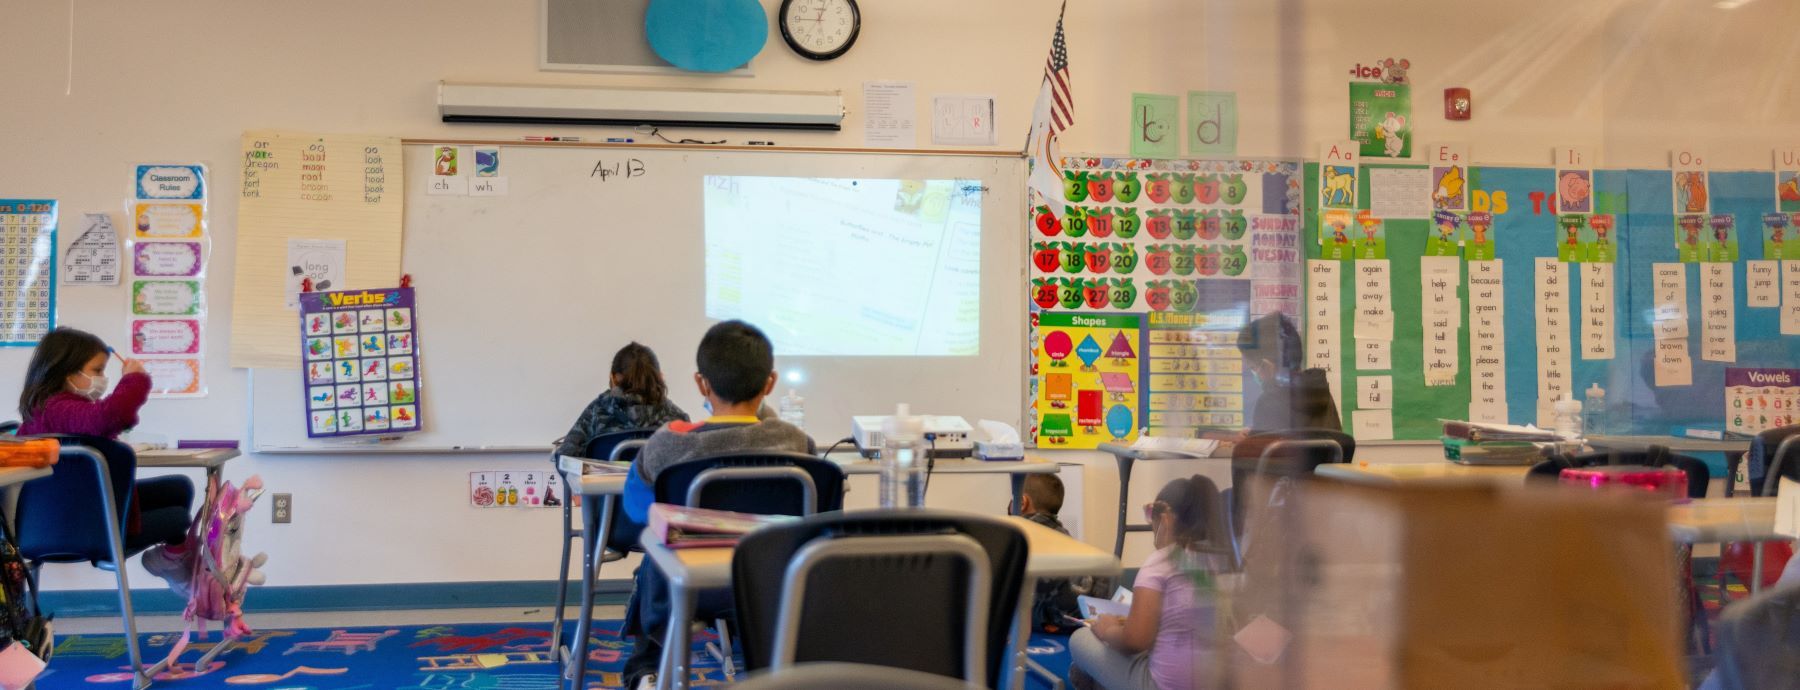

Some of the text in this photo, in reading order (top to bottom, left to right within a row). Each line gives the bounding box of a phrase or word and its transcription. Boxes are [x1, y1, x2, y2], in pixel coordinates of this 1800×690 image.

[1350, 63, 1382, 78] -ice
[974, 117, 980, 128] R
[1197, 104, 1220, 144] d
[254, 140, 270, 149] or
[310, 144, 324, 152] oo
[364, 146, 378, 154] oo
[1328, 145, 1352, 160] A a
[1440, 146, 1459, 161] E e
[244, 159, 279, 170] Oregon
[1679, 152, 1692, 166] O
[1783, 152, 1793, 166] U
[591, 158, 646, 182] April 13
[434, 182, 449, 190] ch
[476, 182, 494, 192] wh
[1072, 184, 1080, 195] 2
[1098, 184, 1106, 196] 3
[1122, 185, 1132, 196] 4
[1156, 186, 1163, 196] 5
[1180, 186, 1188, 197] 6
[1204, 186, 1212, 197] 7
[1228, 186, 1236, 198] 8
[1046, 218, 1054, 228] 9
[1068, 220, 1082, 230] 10
[1096, 220, 1106, 230] 11
[1120, 220, 1132, 232] 12
[1153, 222, 1166, 232] 13
[1177, 221, 1190, 232] 14
[1203, 222, 1216, 232] 15
[1226, 222, 1239, 234] 16
[1252, 216, 1296, 230] SUNDAY
[1252, 234, 1296, 247] MONDAY
[1042, 254, 1054, 265] 17
[1067, 254, 1080, 266] 18
[1092, 255, 1106, 266] 19
[1252, 248, 1296, 262] TUESDAY
[305, 260, 328, 273] long
[1114, 255, 1132, 268] 20
[1152, 258, 1165, 269] 21
[1176, 257, 1190, 269] 22
[1224, 258, 1240, 270] 24
[1546, 261, 1557, 273] big
[1313, 264, 1331, 273] after
[1363, 266, 1382, 276] again
[1481, 263, 1490, 272] be
[1592, 264, 1602, 275] by
[1711, 266, 1721, 275] for
[1753, 264, 1771, 276] funny
[1432, 279, 1446, 290] help
[1471, 275, 1500, 284] because
[1547, 276, 1557, 284] did
[1591, 278, 1604, 287] find
[1661, 279, 1678, 288] from
[1710, 279, 1723, 288] four
[1038, 290, 1055, 301] 25
[1064, 290, 1080, 301] 26
[1090, 290, 1106, 301] 27
[1114, 290, 1130, 302] 28
[1255, 284, 1298, 298] THURSDAY
[1316, 292, 1328, 301] ask
[1544, 291, 1559, 300] give
[1665, 291, 1674, 301] of
[329, 292, 386, 306] Verbs
[1152, 293, 1166, 304] 29
[1174, 292, 1193, 304] 30
[1362, 294, 1383, 302] away
[1713, 295, 1722, 303] go
[1364, 307, 1383, 315] make
[1476, 306, 1496, 314] green
[1546, 304, 1558, 313] him
[1590, 304, 1605, 313] kind
[1709, 309, 1727, 318] going
[1072, 316, 1106, 327] Shapes
[1433, 318, 1447, 327] said
[1481, 317, 1490, 326] he
[1548, 317, 1557, 326] his
[1592, 317, 1603, 326] like
[1708, 322, 1727, 330] know
[1478, 330, 1494, 339] here
[1591, 344, 1604, 353] ride
[1660, 341, 1683, 350] brown
[1316, 349, 1330, 358] and
[1663, 354, 1682, 363] down
[1429, 359, 1452, 370] yellow
[1476, 355, 1499, 366] please
[1547, 370, 1560, 378] little
[1748, 371, 1791, 383] Vowels
[1482, 381, 1493, 390] the
